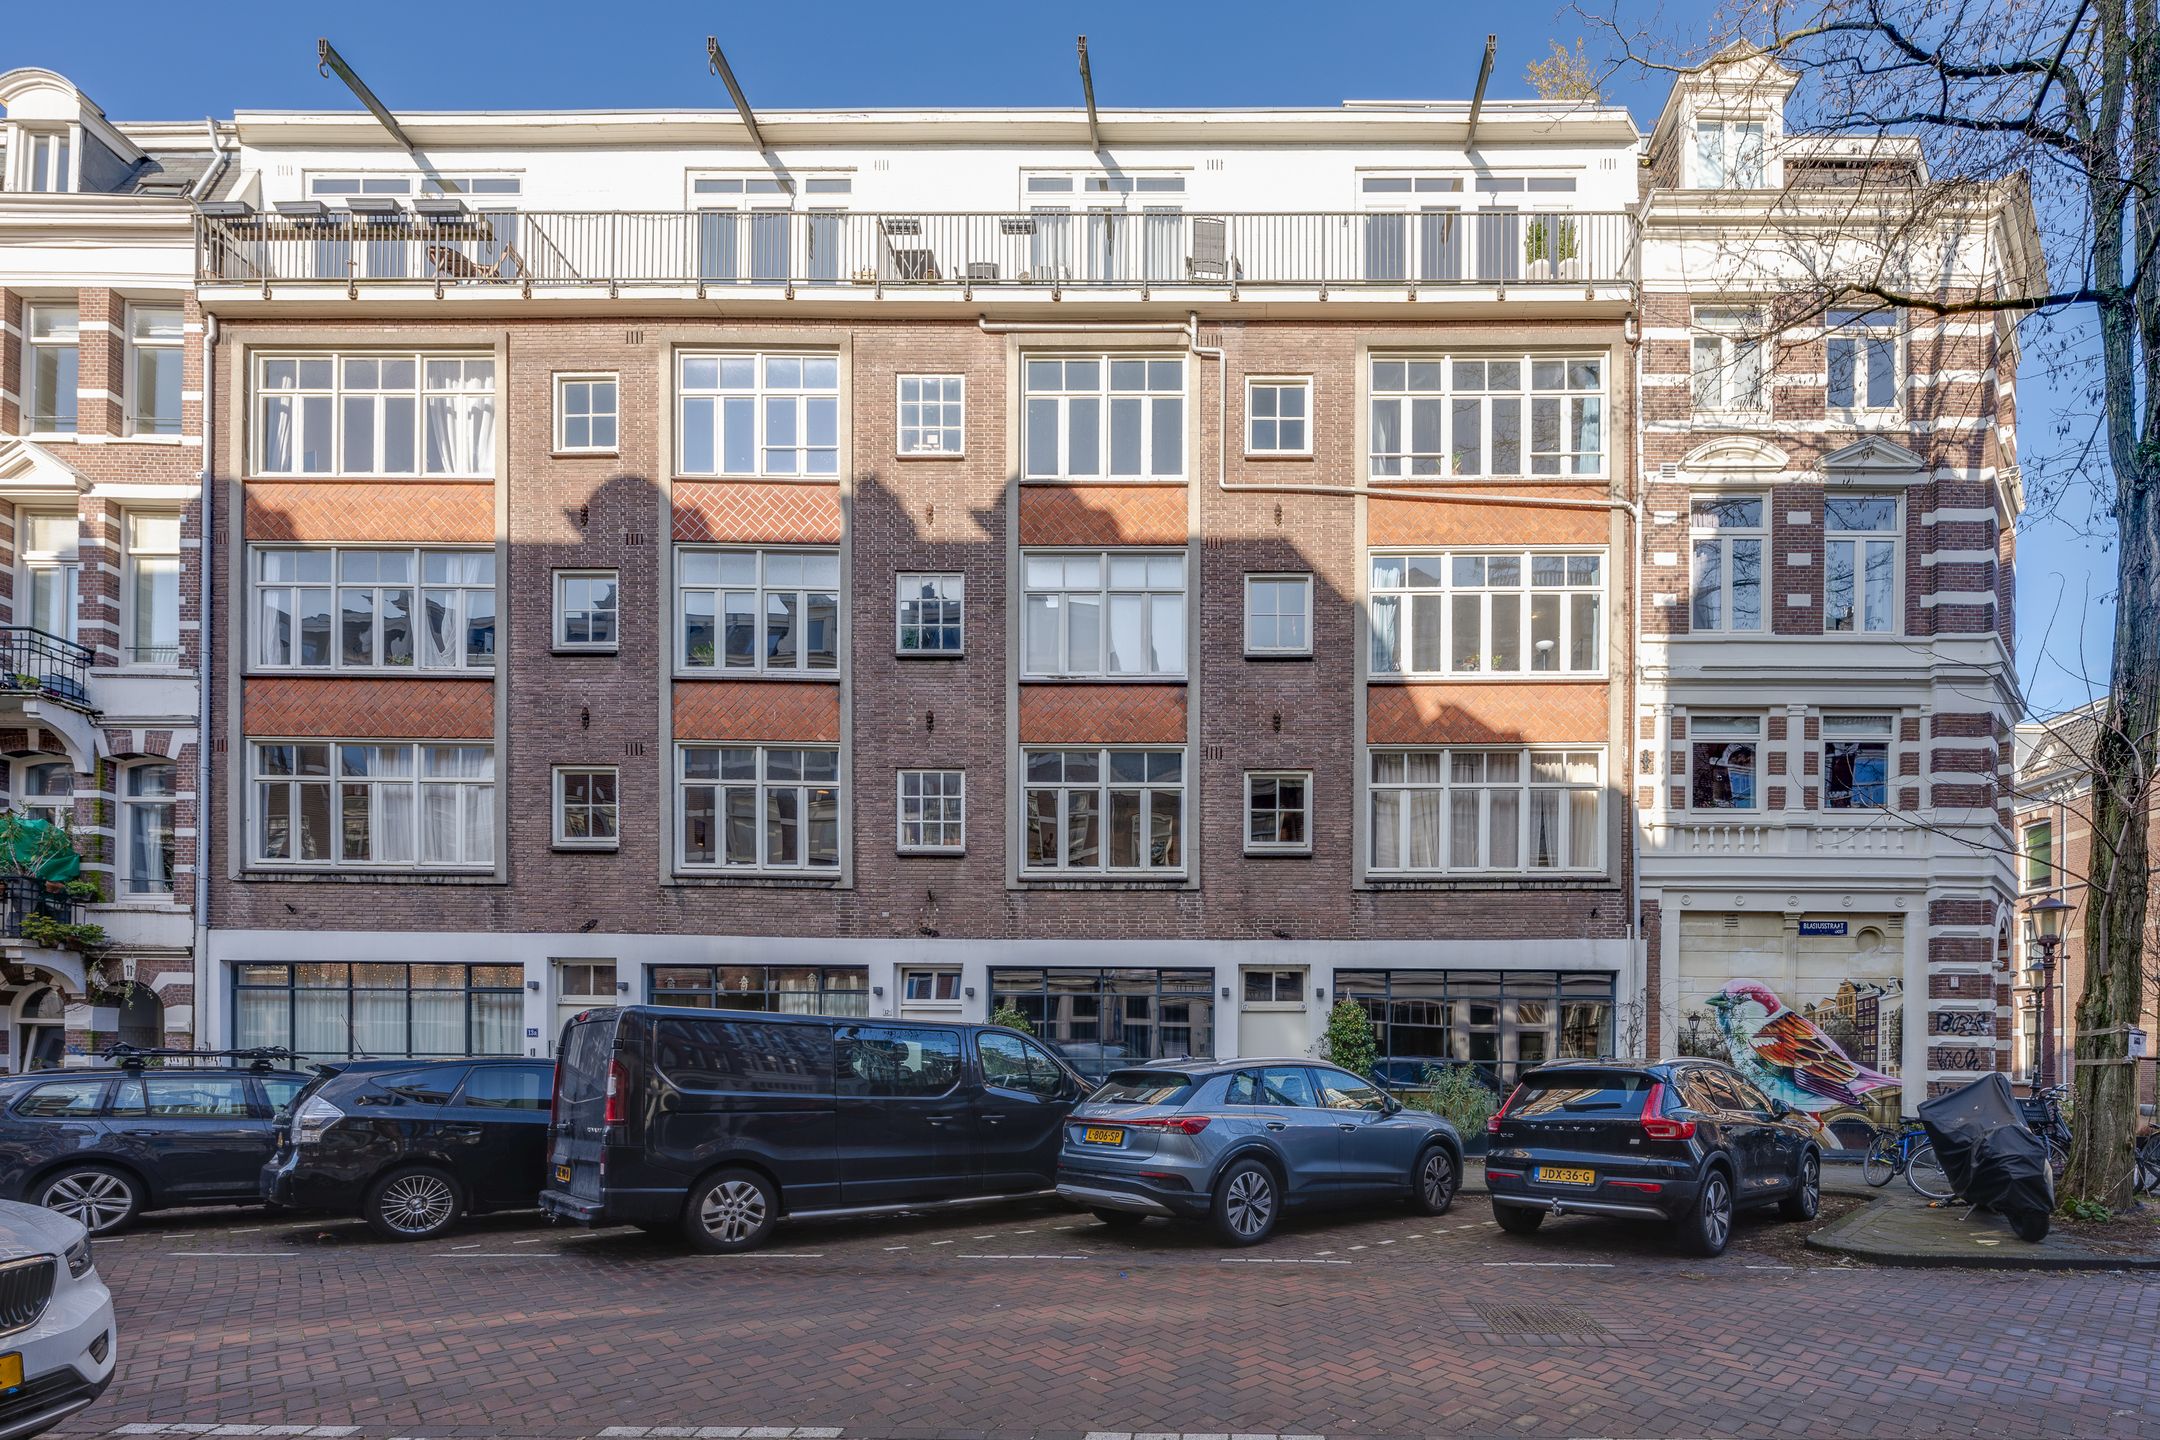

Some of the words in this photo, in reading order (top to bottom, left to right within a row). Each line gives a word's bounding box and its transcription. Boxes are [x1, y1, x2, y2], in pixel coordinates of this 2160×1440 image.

[1803, 922, 1845, 930] BLASIUSSTRAAT
[1088, 1129, 1120, 1142] L-806-SP
[1542, 1168, 1590, 1181] JDX-36-G
